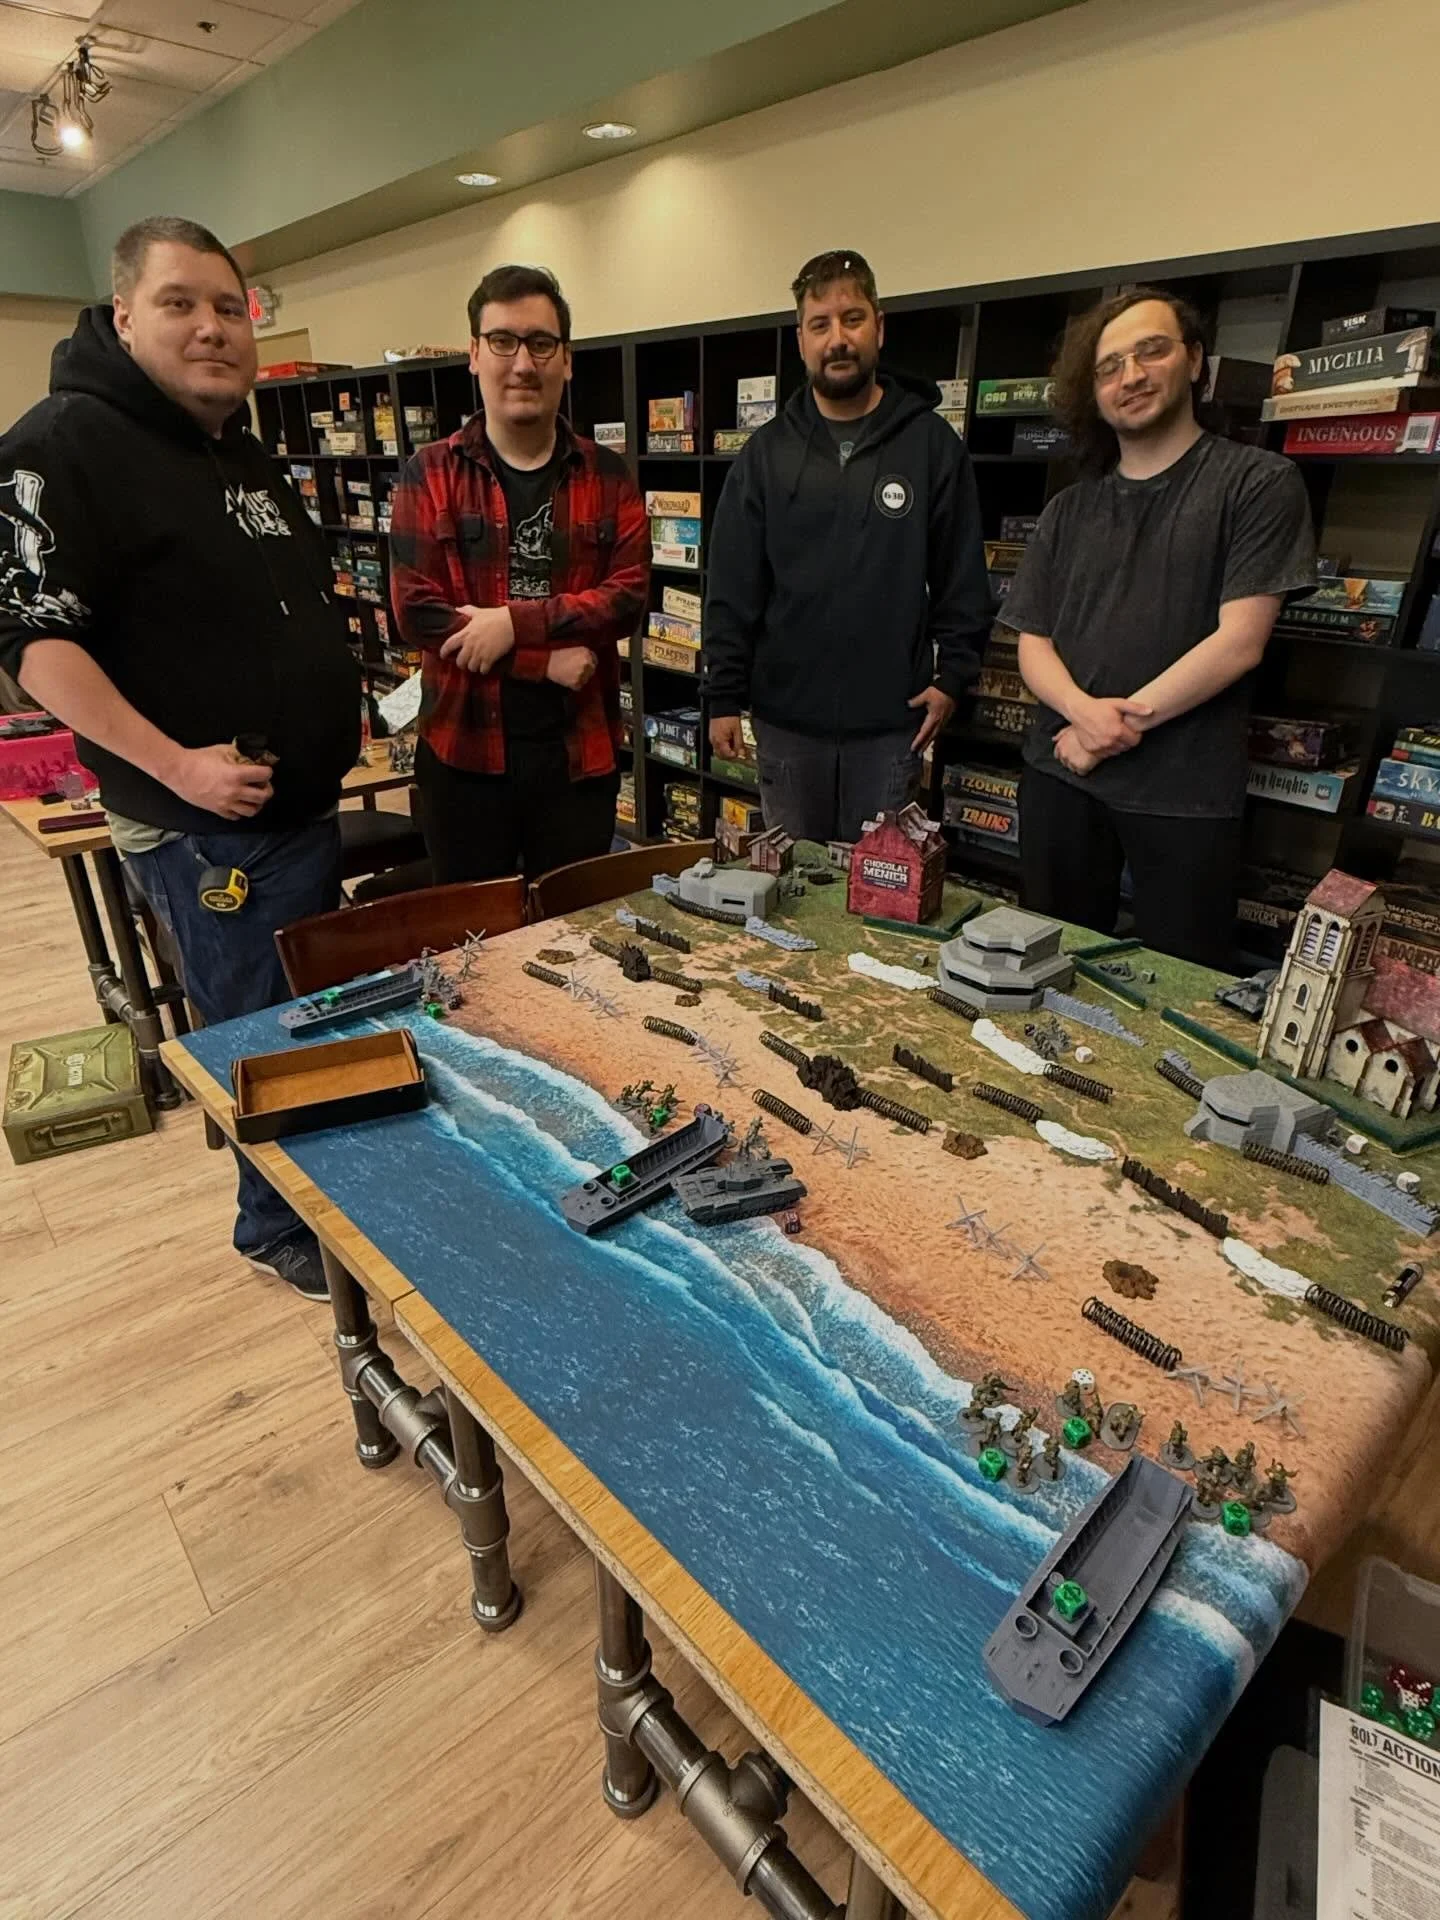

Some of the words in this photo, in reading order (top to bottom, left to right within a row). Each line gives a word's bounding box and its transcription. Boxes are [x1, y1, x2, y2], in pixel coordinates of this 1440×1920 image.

[1308, 346, 1384, 374] MYCELIA
[1284, 609, 1350, 625] STRATUM
[659, 721, 681, 739] PLANET
[1396, 769, 1440, 794] SKY
[960, 806, 1012, 834] TRAINS
[863, 858, 909, 873] CHOCOLAT
[863, 866, 908, 883] MENIER
[1351, 1724, 1379, 1748] BOLT
